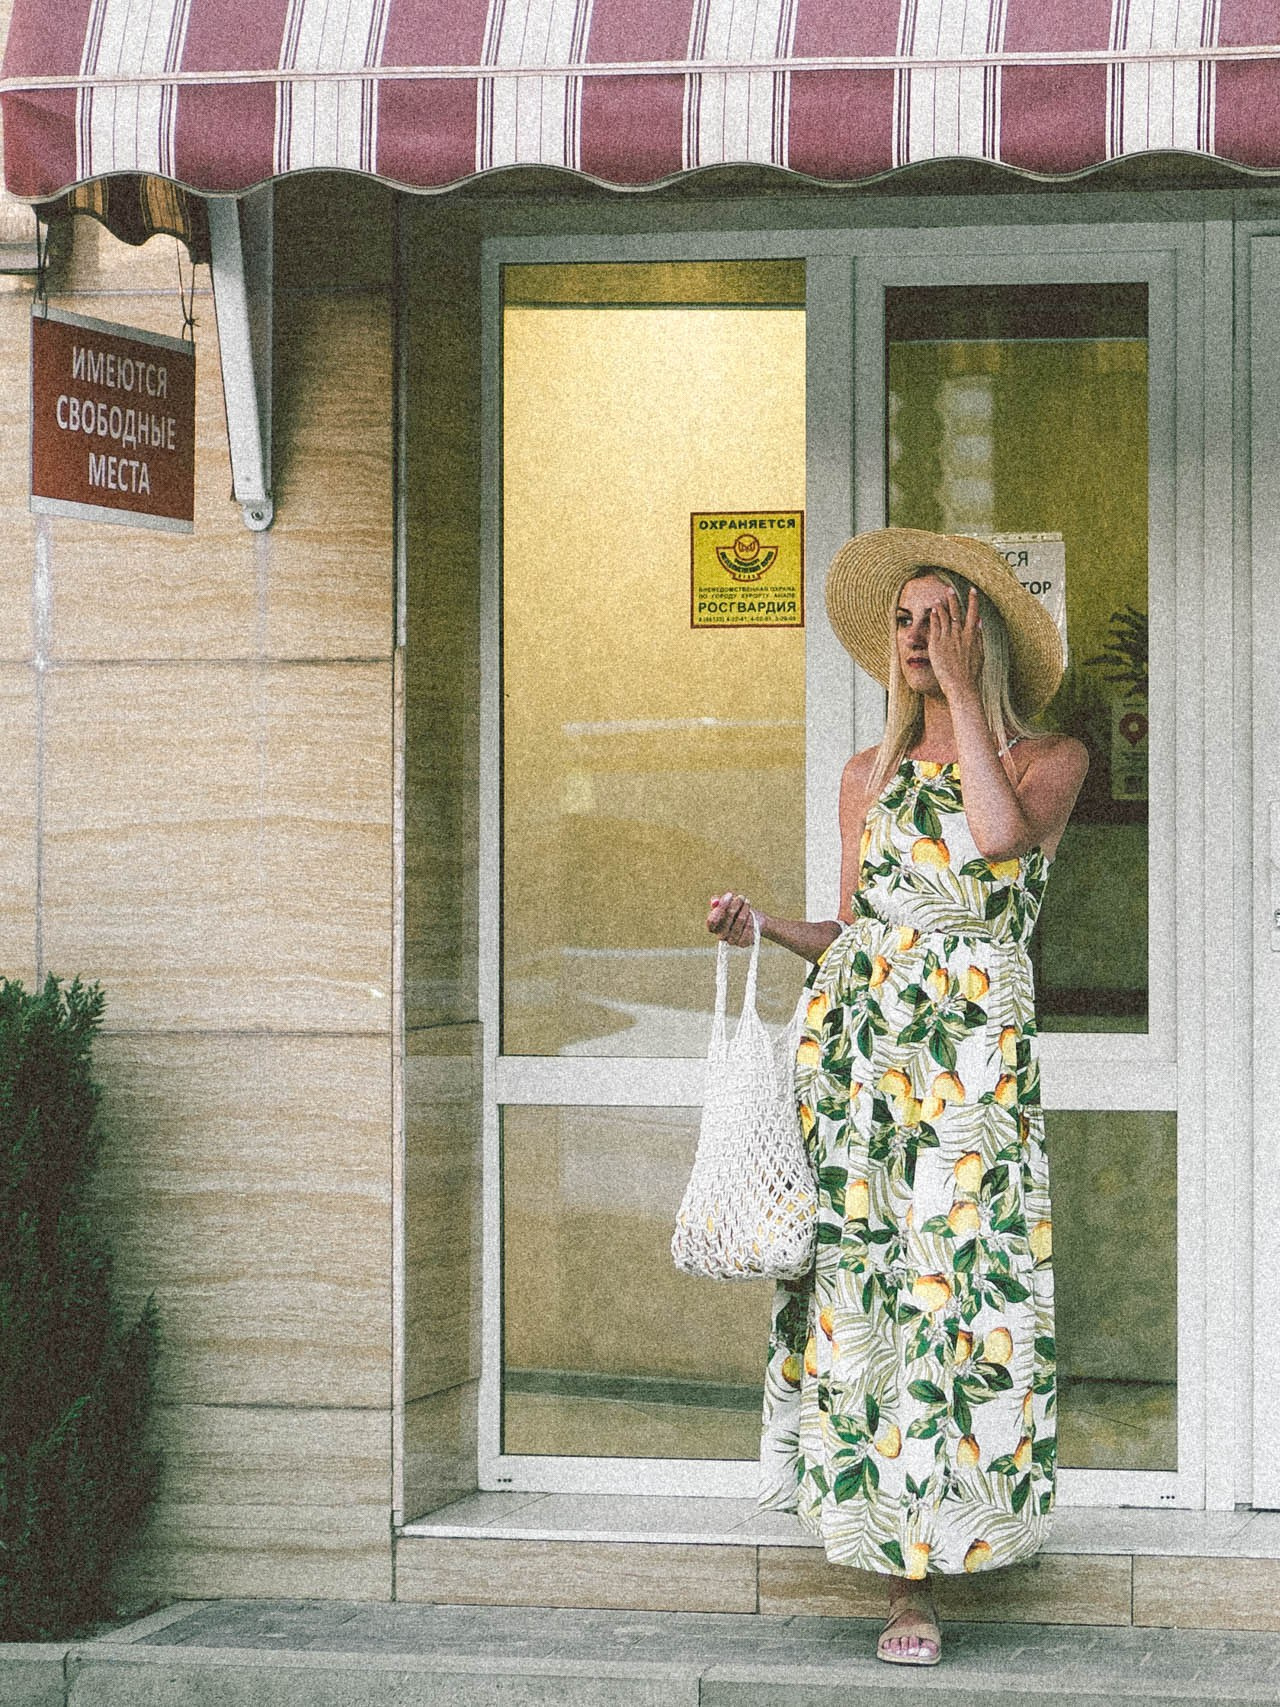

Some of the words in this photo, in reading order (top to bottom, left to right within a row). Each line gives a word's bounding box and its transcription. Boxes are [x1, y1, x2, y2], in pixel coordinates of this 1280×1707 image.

[72, 346, 168, 399] ИМЕЮТСЯ
[56, 394, 176, 450] СВОБОДНЫЕ
[88, 452, 151, 496] МЕСТА
[699, 519, 796, 530] ОХРАНЯЕТСЯ
[999, 550, 1028, 568] СЯ
[698, 601, 797, 615] РОСГВАРДИЯ
